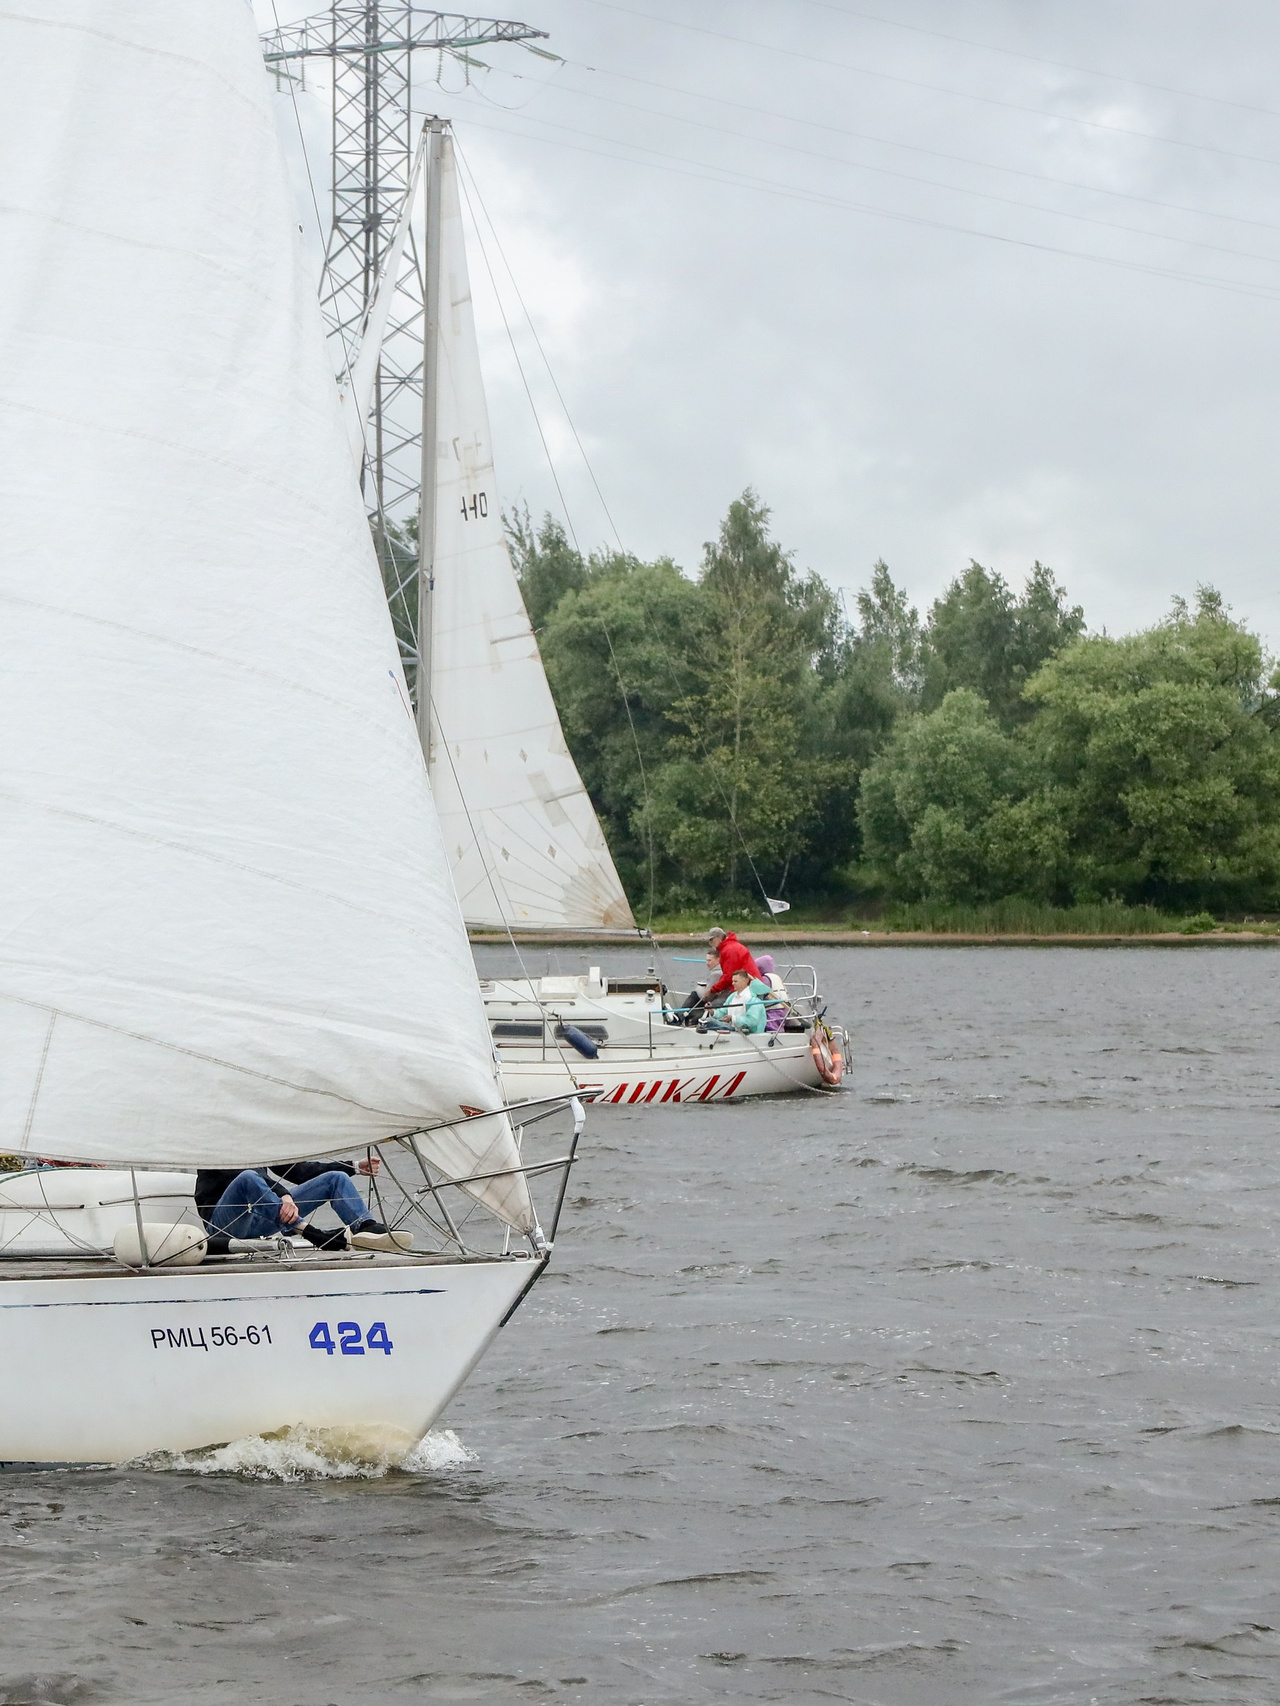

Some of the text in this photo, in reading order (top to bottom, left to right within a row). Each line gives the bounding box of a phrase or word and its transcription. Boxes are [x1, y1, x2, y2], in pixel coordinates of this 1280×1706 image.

[150, 1324, 273, 1352] РМЦ 56-61
[308, 1321, 394, 1356] 424
